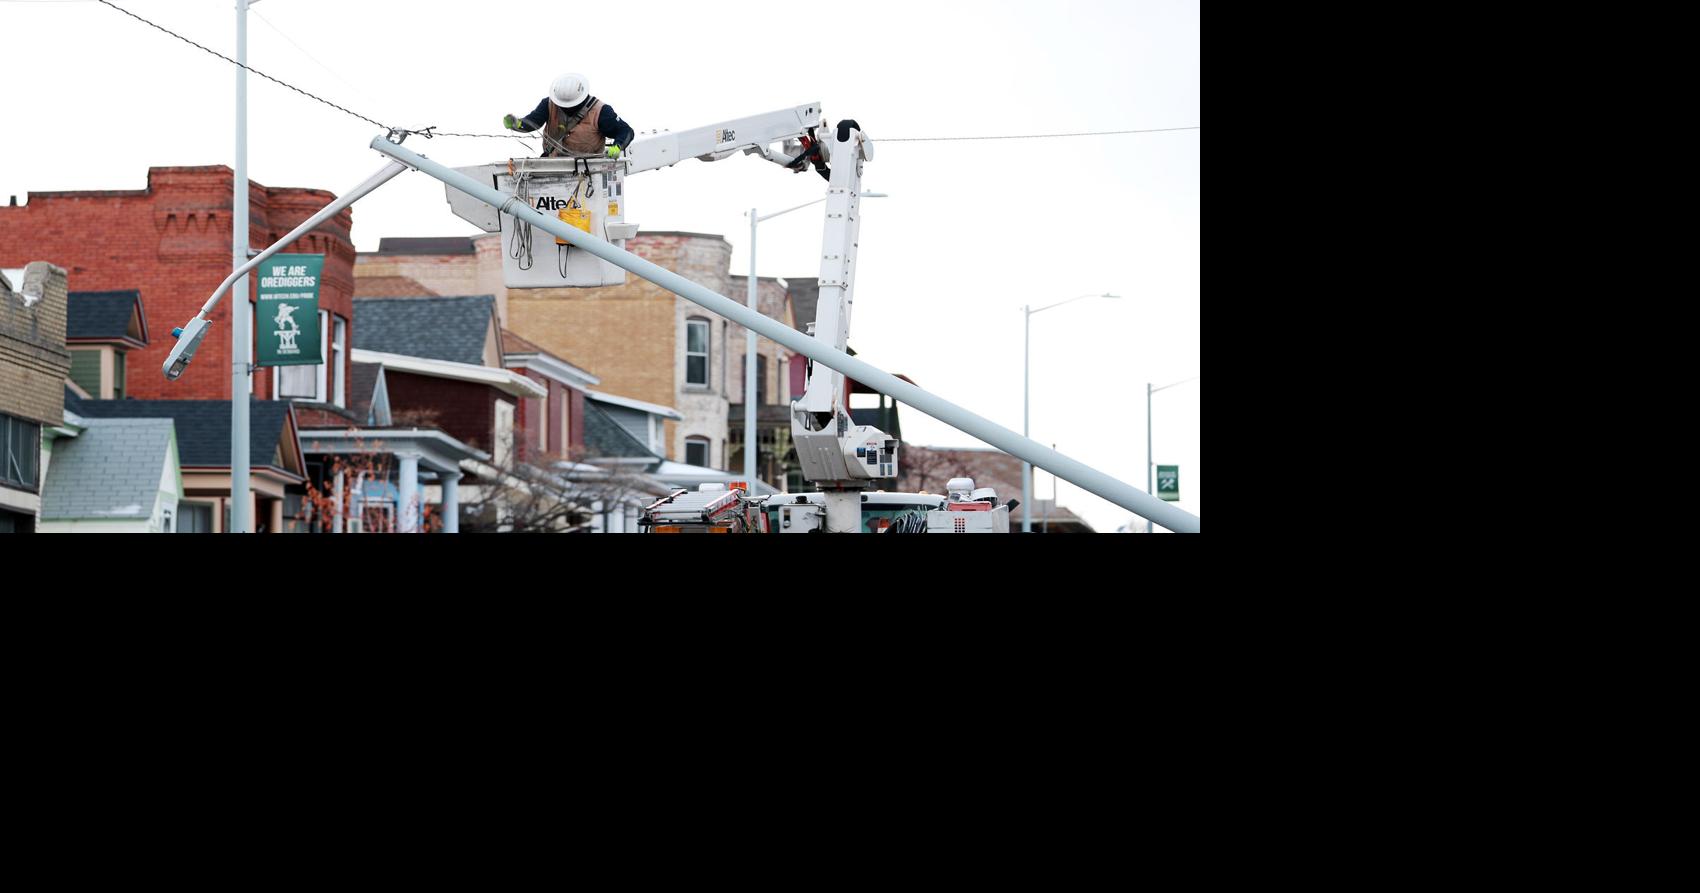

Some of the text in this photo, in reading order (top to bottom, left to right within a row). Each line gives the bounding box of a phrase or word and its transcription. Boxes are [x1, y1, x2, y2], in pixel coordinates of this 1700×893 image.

[721, 128, 735, 143] Altec
[272, 266, 306, 276] WE ARE
[261, 277, 315, 287] OREDIGGERS
